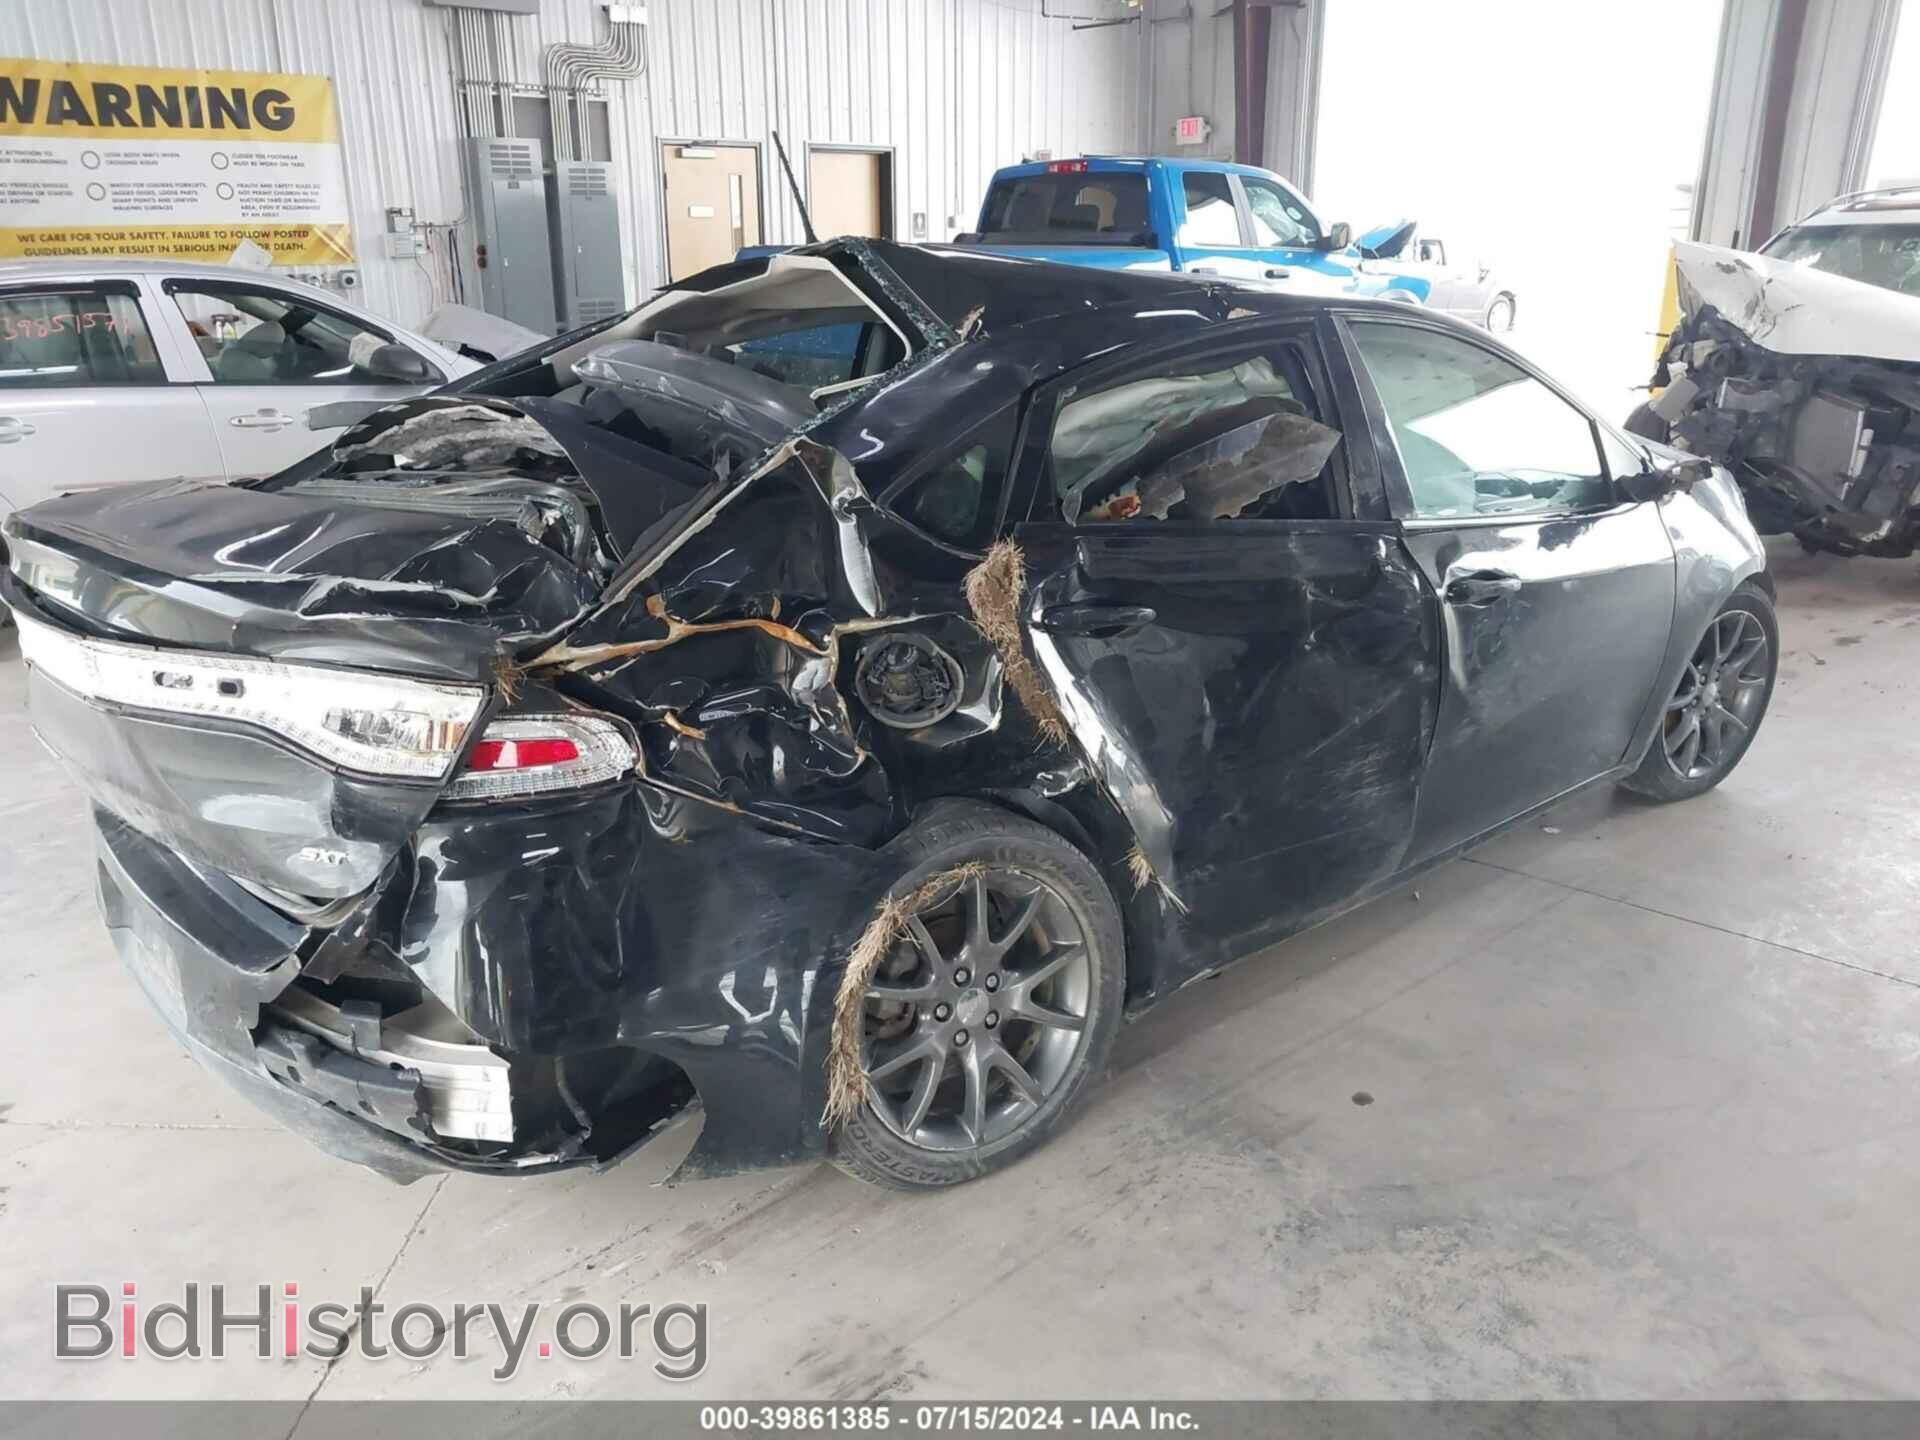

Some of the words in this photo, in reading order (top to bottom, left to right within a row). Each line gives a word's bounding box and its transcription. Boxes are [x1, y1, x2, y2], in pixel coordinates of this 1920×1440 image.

[0, 76, 295, 132] WARNING
[16, 233, 35, 243] WE
[39, 233, 67, 242] CARE
[70, 232, 91, 242] FOR
[94, 232, 126, 242] YOUR
[172, 231, 211, 240] FAILURE
[214, 231, 227, 239] TO
[230, 230, 271, 239] FOLLOW
[273, 230, 309, 239] POSTED
[23, 246, 89, 257] GUIDELINES
[91, 246, 115, 256] MAY
[118, 245, 154, 255] RESULT
[158, 244, 170, 254] IN
[173, 243, 215, 253] SERIOUS
[273, 242, 306, 251] DEATH.
[300, 846, 353, 867] SXT
